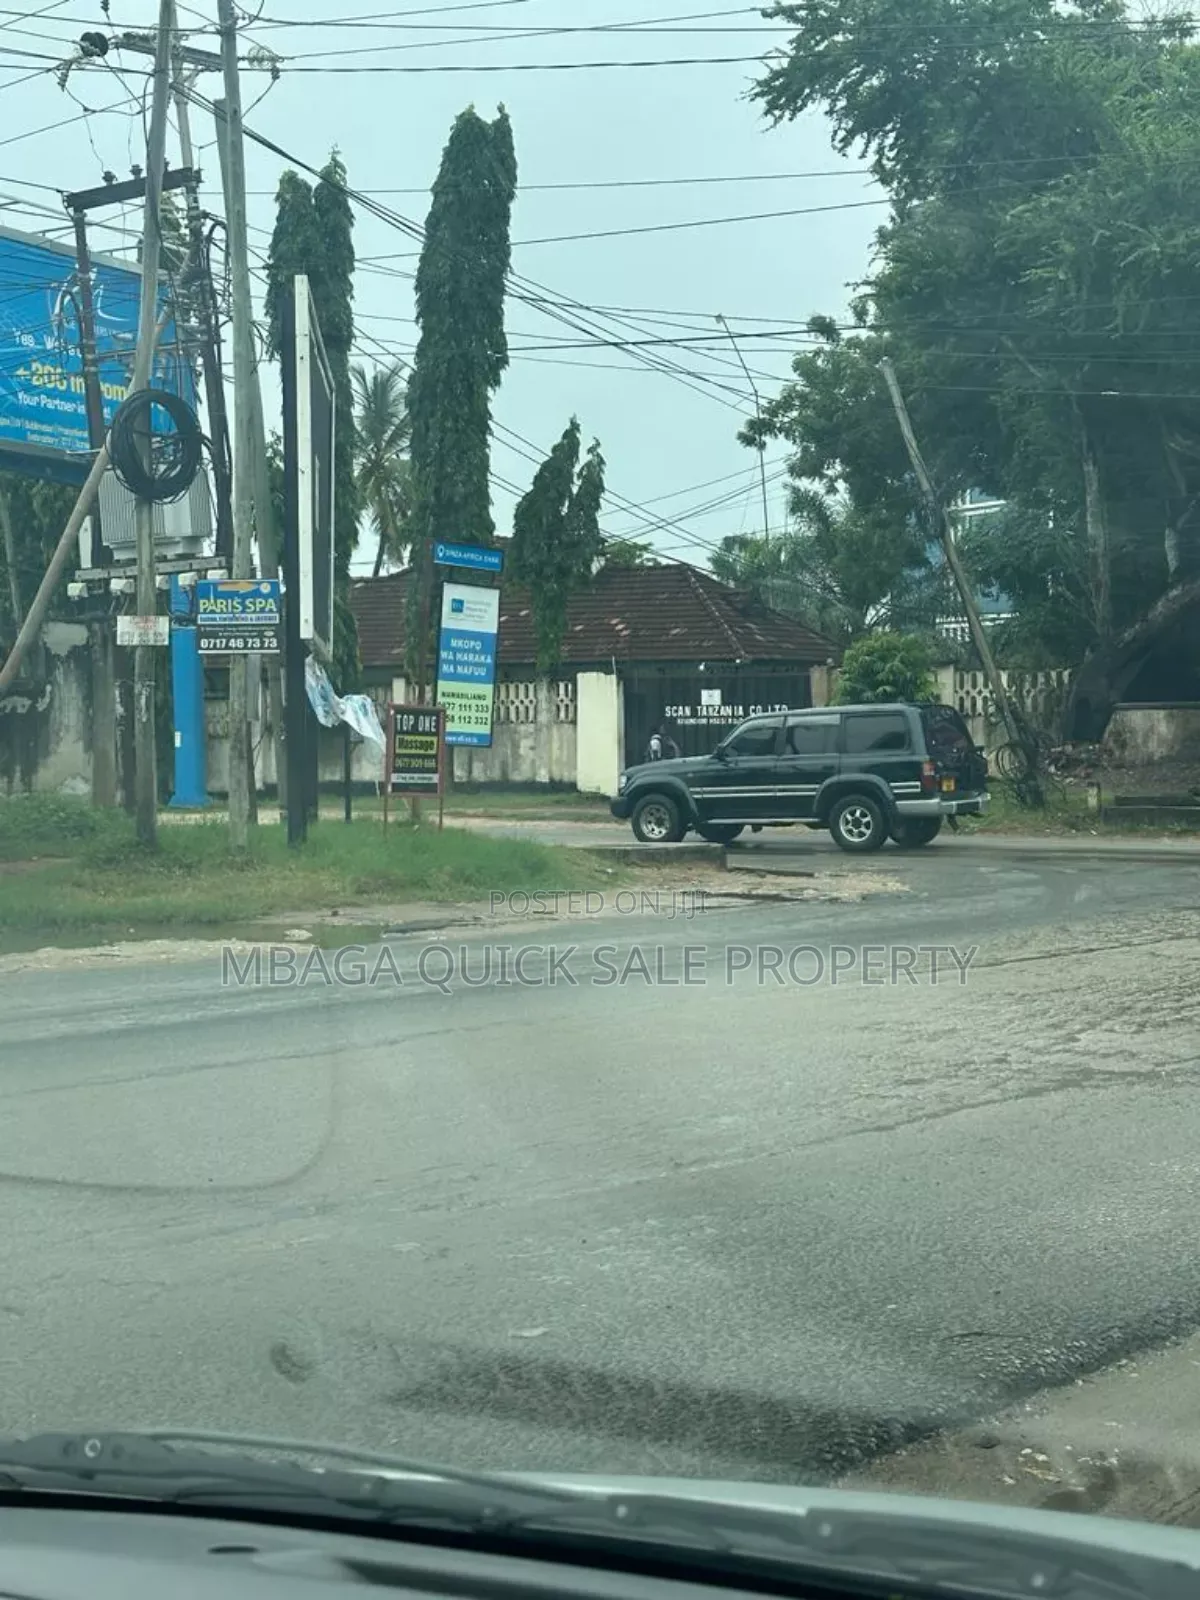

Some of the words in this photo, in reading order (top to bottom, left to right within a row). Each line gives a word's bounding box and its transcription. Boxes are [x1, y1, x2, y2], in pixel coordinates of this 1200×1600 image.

[16, 390, 39, 406] Your
[40, 394, 76, 412] Partner
[199, 597, 243, 613] PARIS
[244, 598, 277, 612] SPA
[200, 638, 227, 649] 0717
[246, 637, 261, 648] 73
[262, 637, 278, 648] 73
[450, 638, 482, 650] MKOPO
[665, 705, 692, 717] SCAN
[696, 705, 744, 717] TANZANIA
[396, 714, 415, 731] TOP
[418, 715, 437, 732] ONE
[398, 737, 435, 752] Massage
